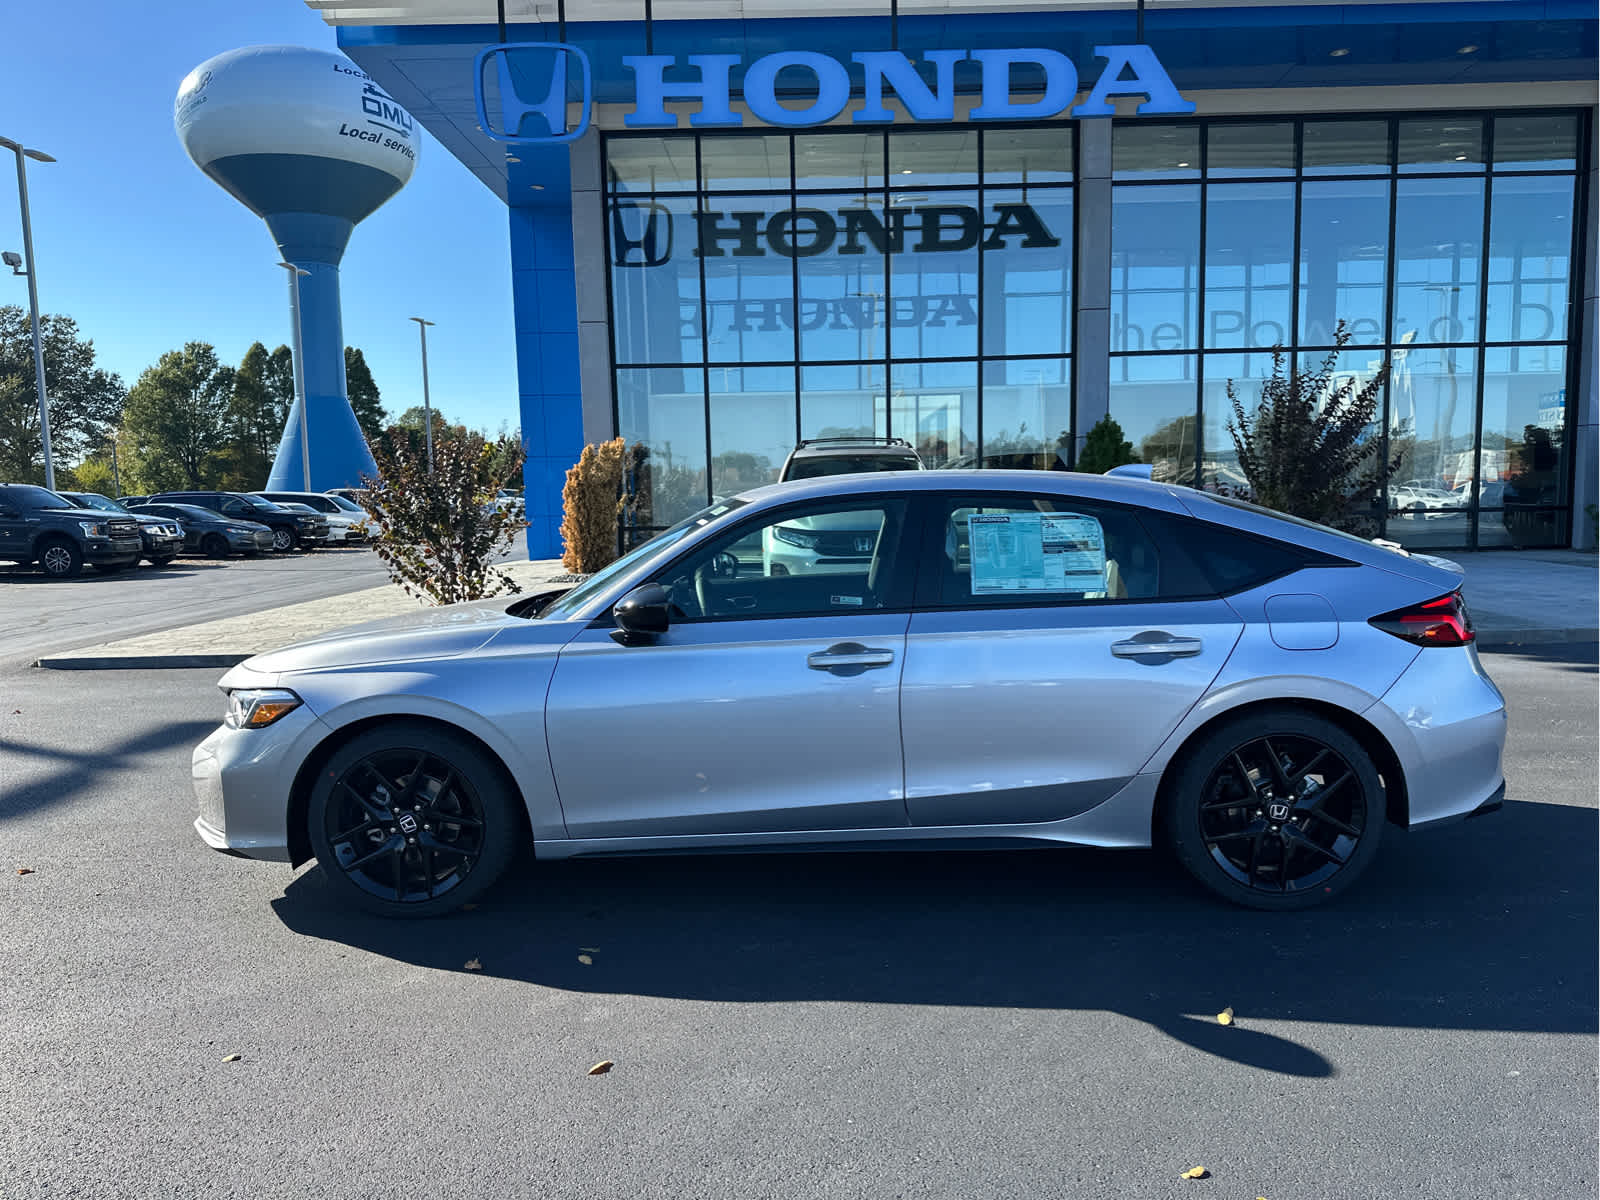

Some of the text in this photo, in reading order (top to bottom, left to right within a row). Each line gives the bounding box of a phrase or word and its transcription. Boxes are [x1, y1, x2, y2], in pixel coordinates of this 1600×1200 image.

[333, 64, 374, 81] Loca
[622, 45, 1197, 126] HONDA
[339, 123, 383, 144] Local
[691, 204, 1061, 258] HONDA
[1112, 312, 1183, 351] he
